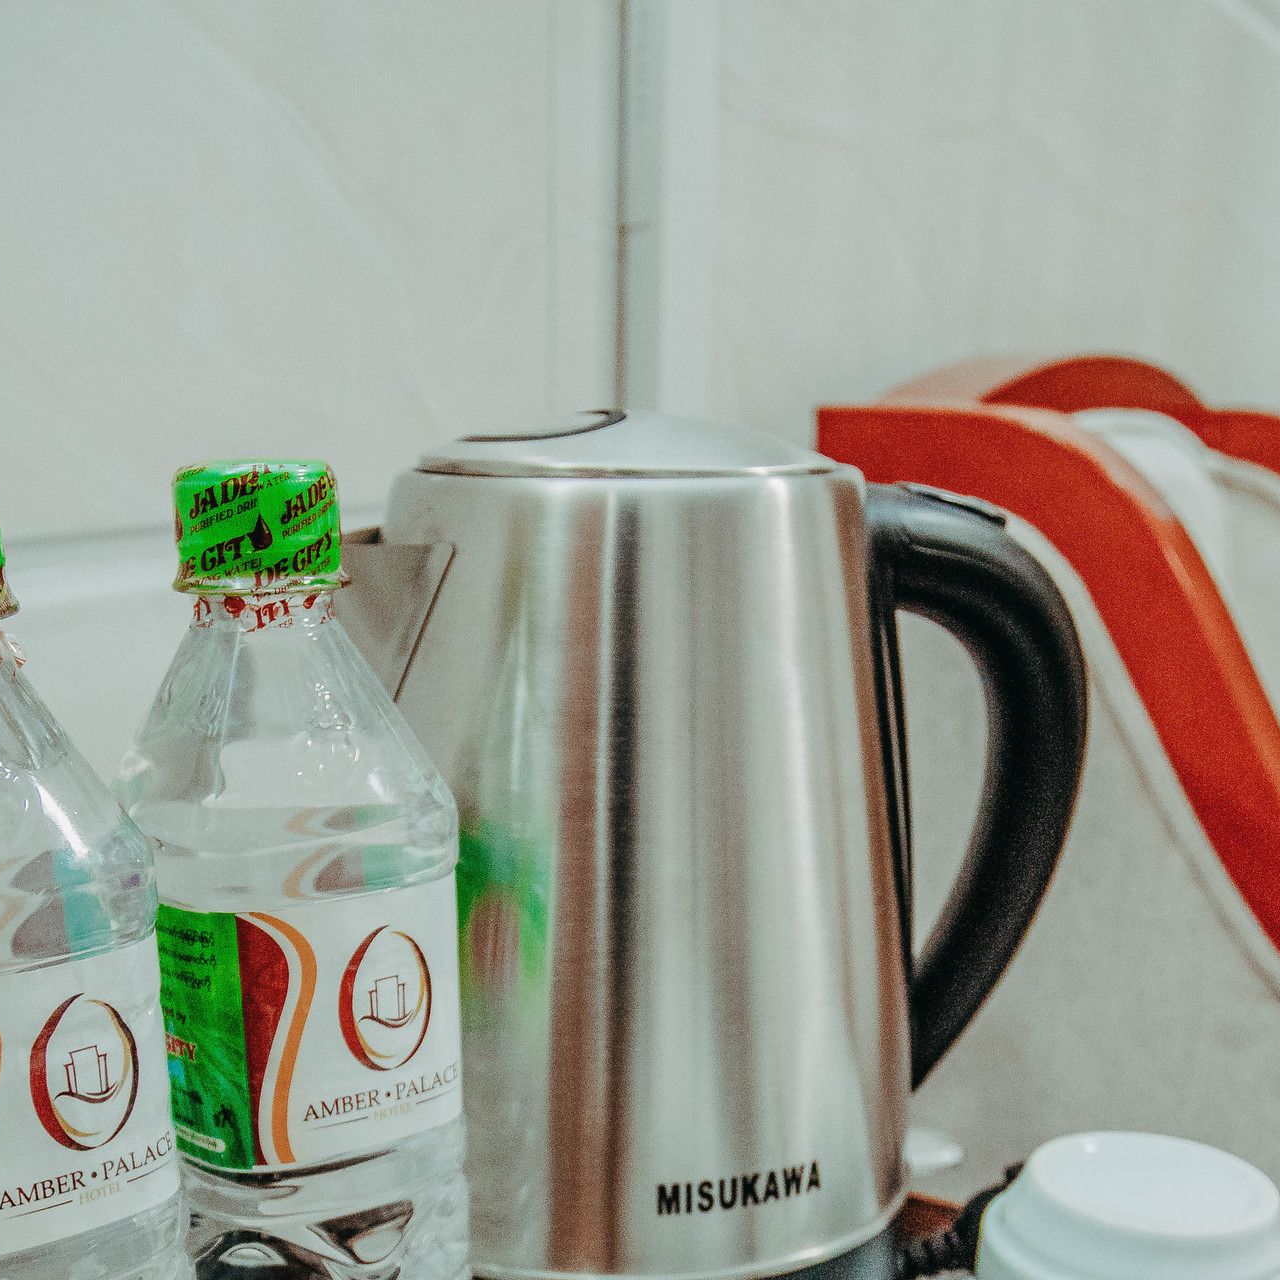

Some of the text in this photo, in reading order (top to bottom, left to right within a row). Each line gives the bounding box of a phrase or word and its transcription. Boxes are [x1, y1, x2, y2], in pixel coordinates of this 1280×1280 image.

[303, 1060, 459, 1122] AMBER PALACE
[101, 1130, 173, 1181] PALACE
[656, 1161, 822, 1216] MISUKAWA
